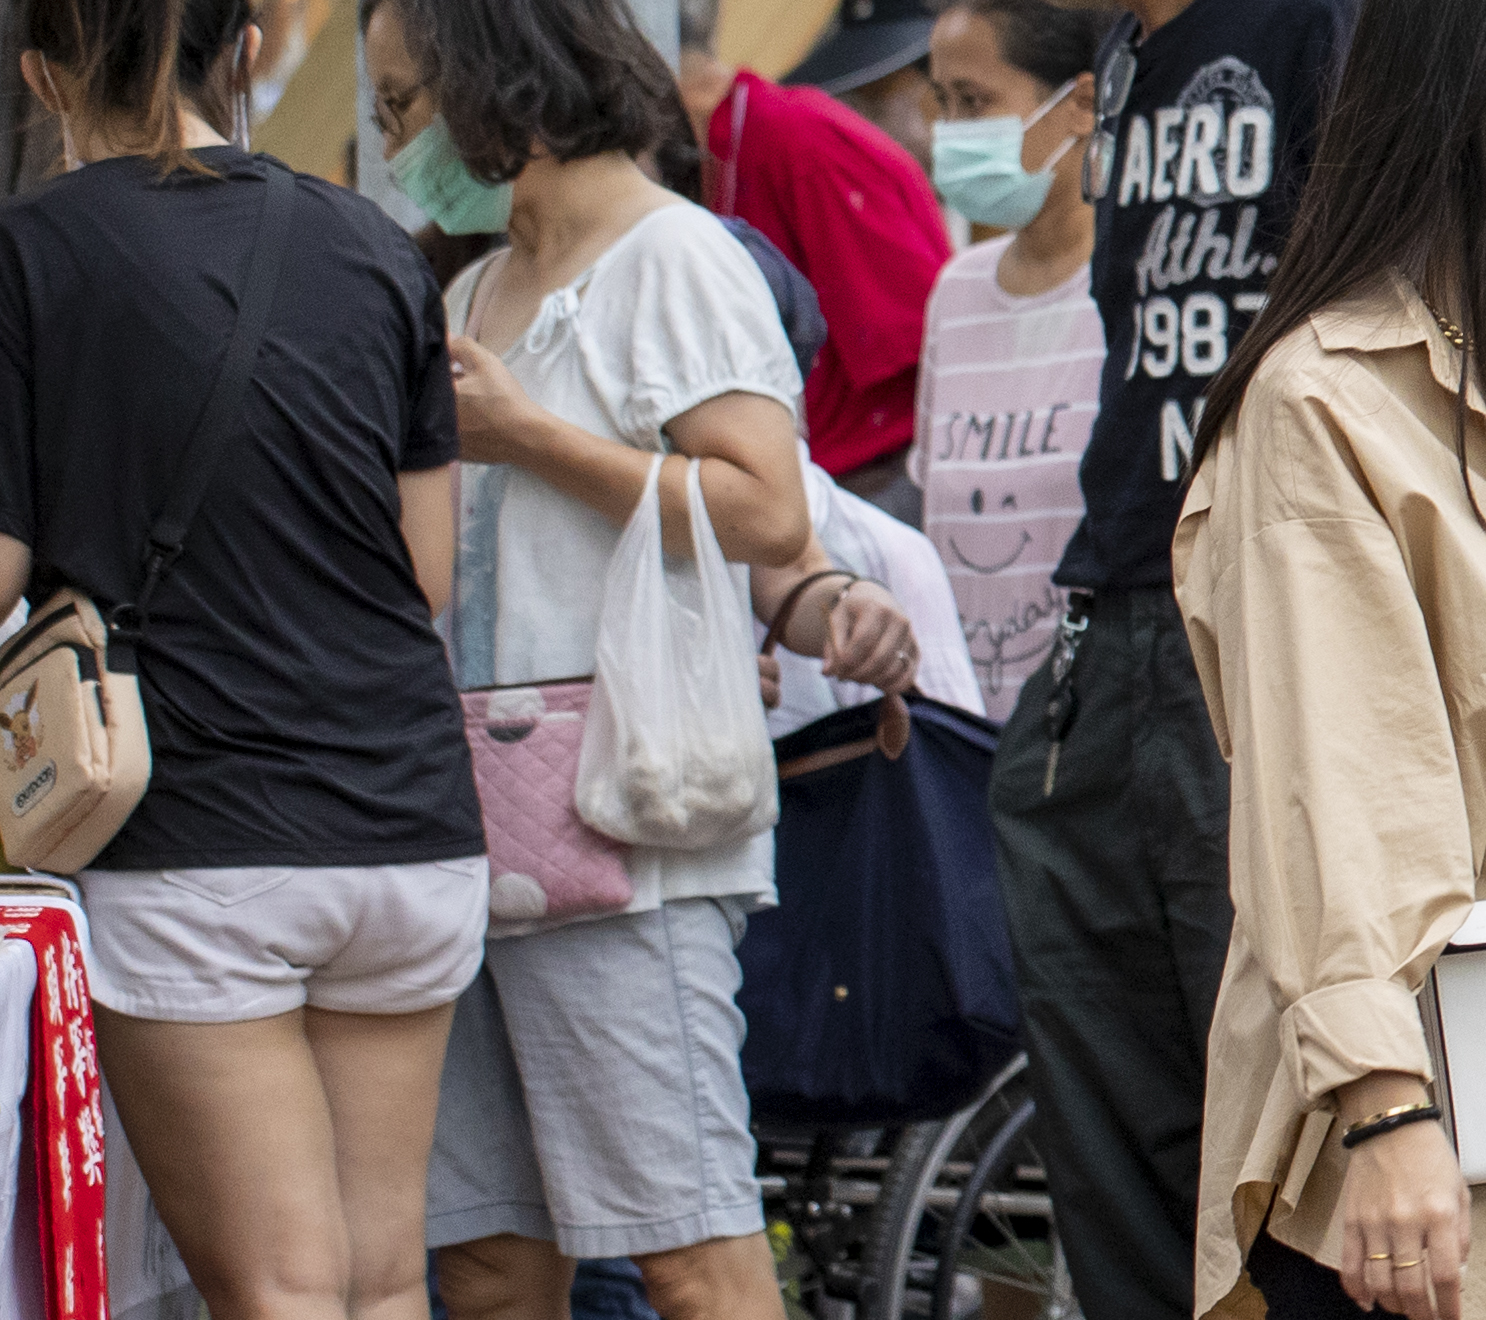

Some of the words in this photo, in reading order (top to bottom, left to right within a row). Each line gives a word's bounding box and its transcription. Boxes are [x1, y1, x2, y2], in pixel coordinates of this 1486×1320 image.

[1117, 103, 1274, 207] AERO
[1135, 204, 1278, 296] Athl.
[938, 402, 1070, 461] SMILE
